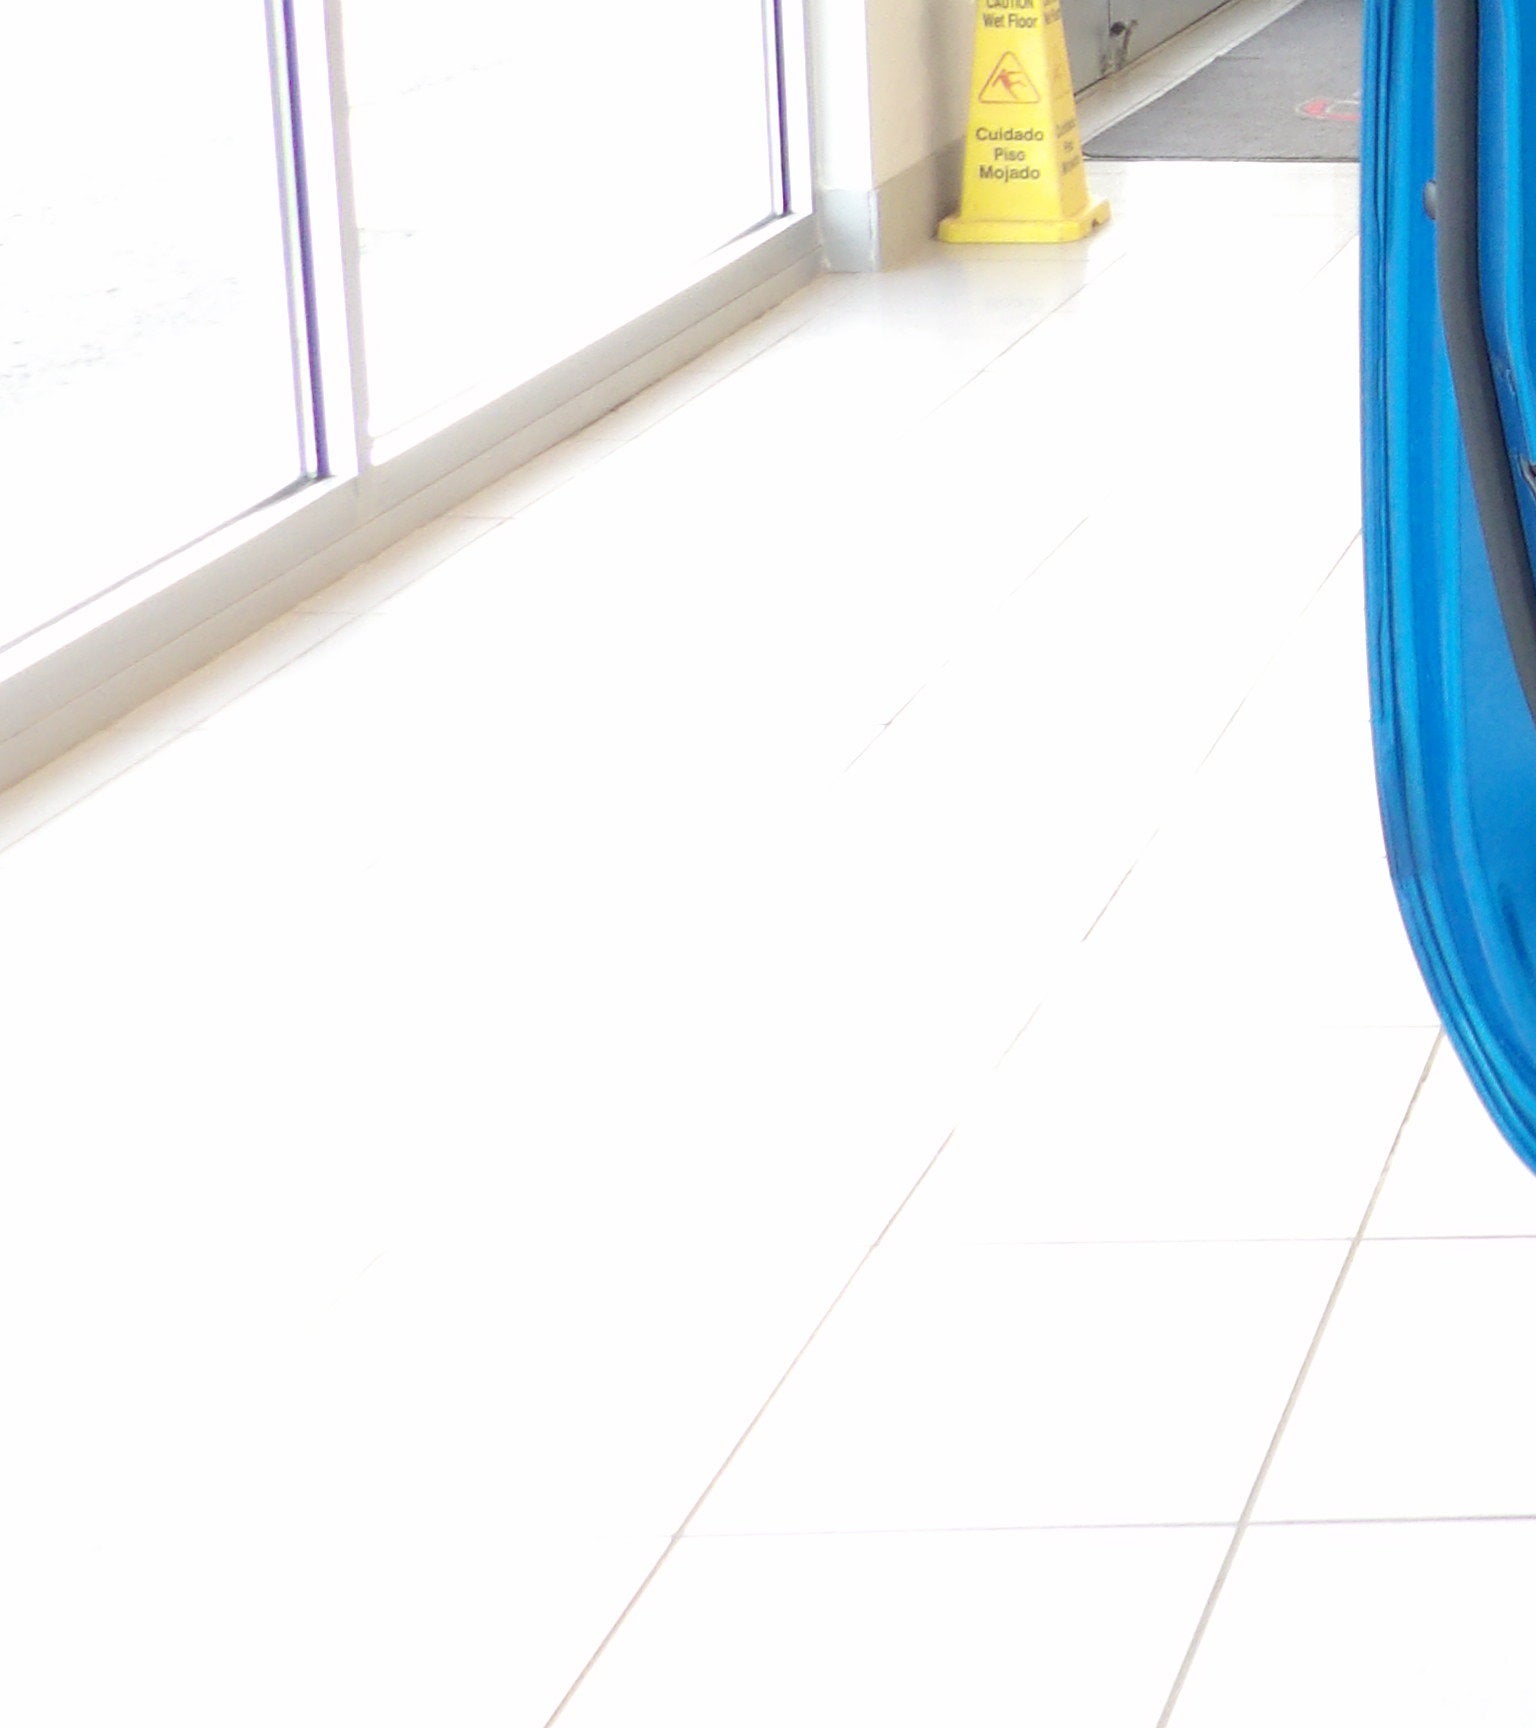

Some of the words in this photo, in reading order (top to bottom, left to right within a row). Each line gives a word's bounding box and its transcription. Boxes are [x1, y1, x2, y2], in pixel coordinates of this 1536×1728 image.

[983, 13, 1005, 28] Wet
[1008, 13, 1039, 29] Floor
[975, 127, 1044, 141] Cuidado
[994, 147, 1026, 161] Piso
[979, 164, 1041, 183] Mojado
